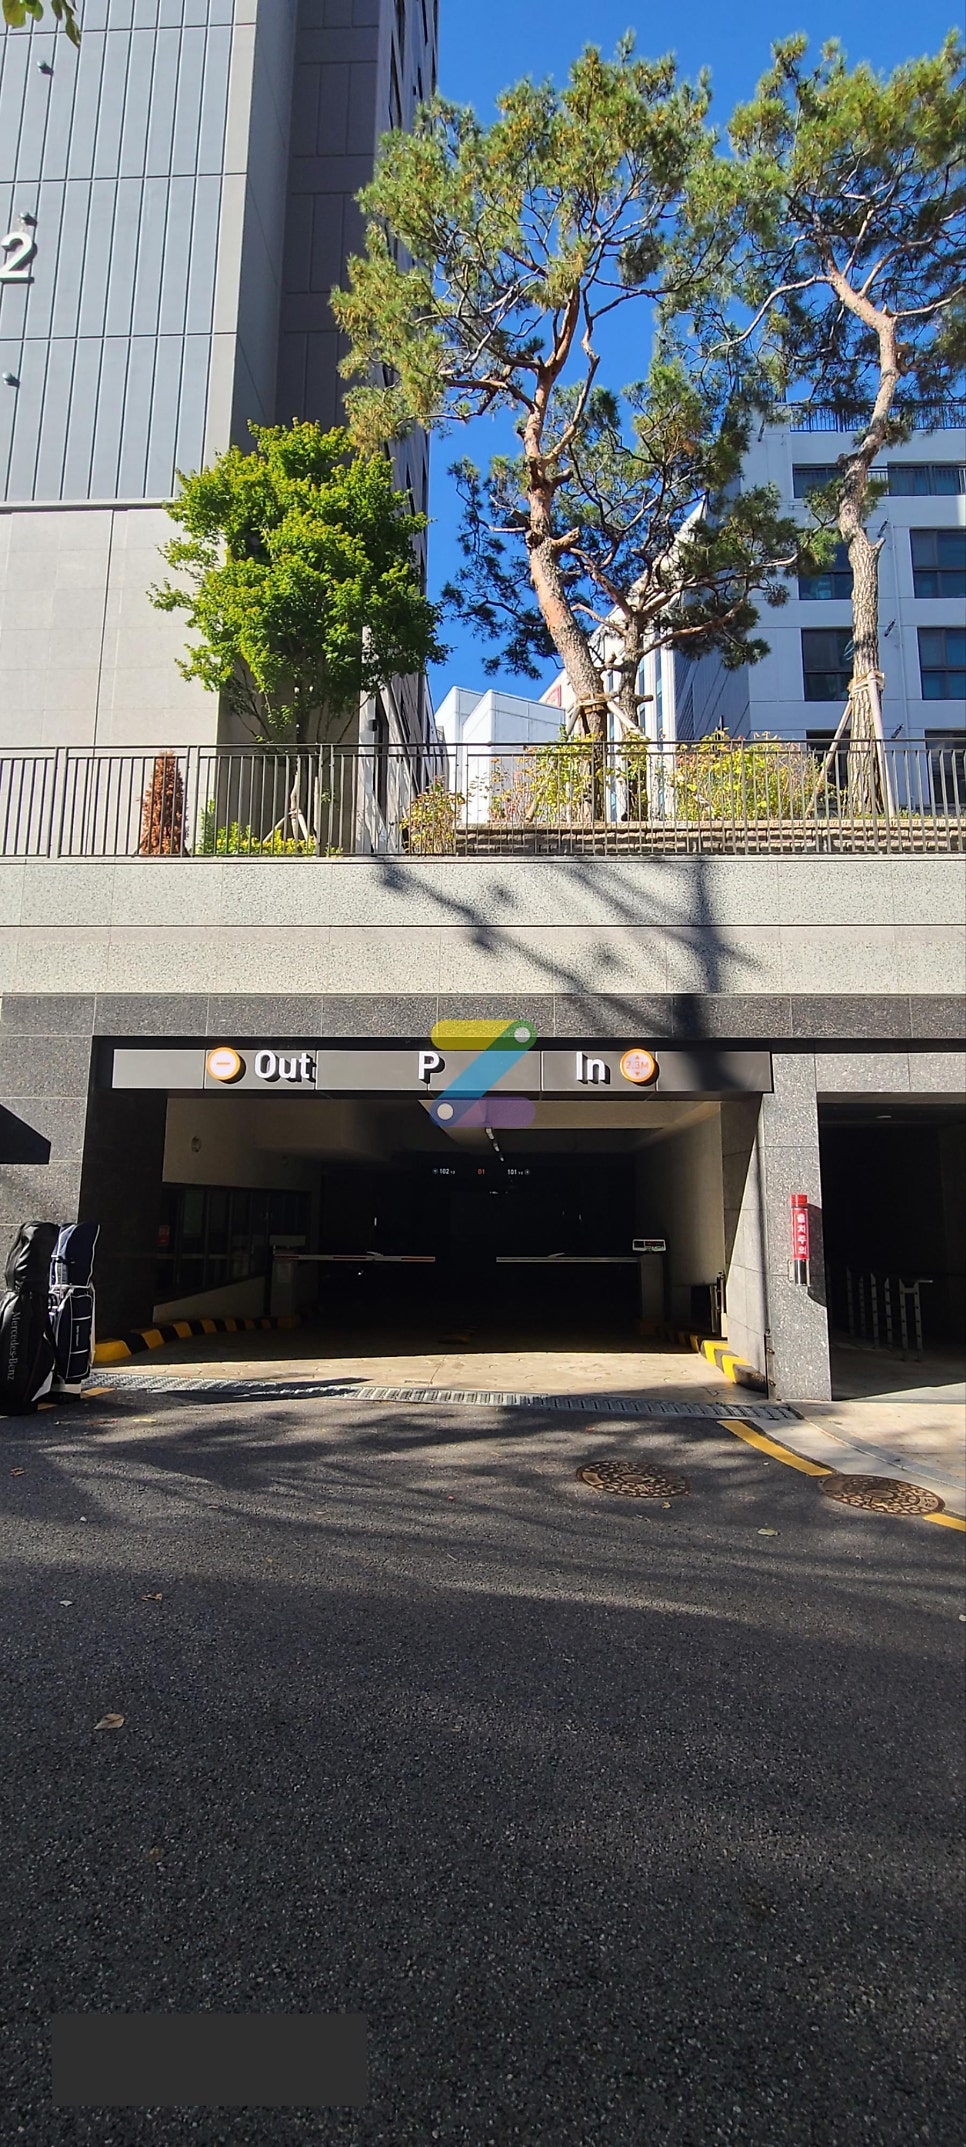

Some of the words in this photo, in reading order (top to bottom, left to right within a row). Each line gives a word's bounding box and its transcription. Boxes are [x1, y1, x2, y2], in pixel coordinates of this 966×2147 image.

[254, 1050, 314, 1080] Out
[418, 1052, 440, 1080] P
[576, 1052, 606, 1081] In
[7, 1311, 21, 1381] Mercedes-Benz
